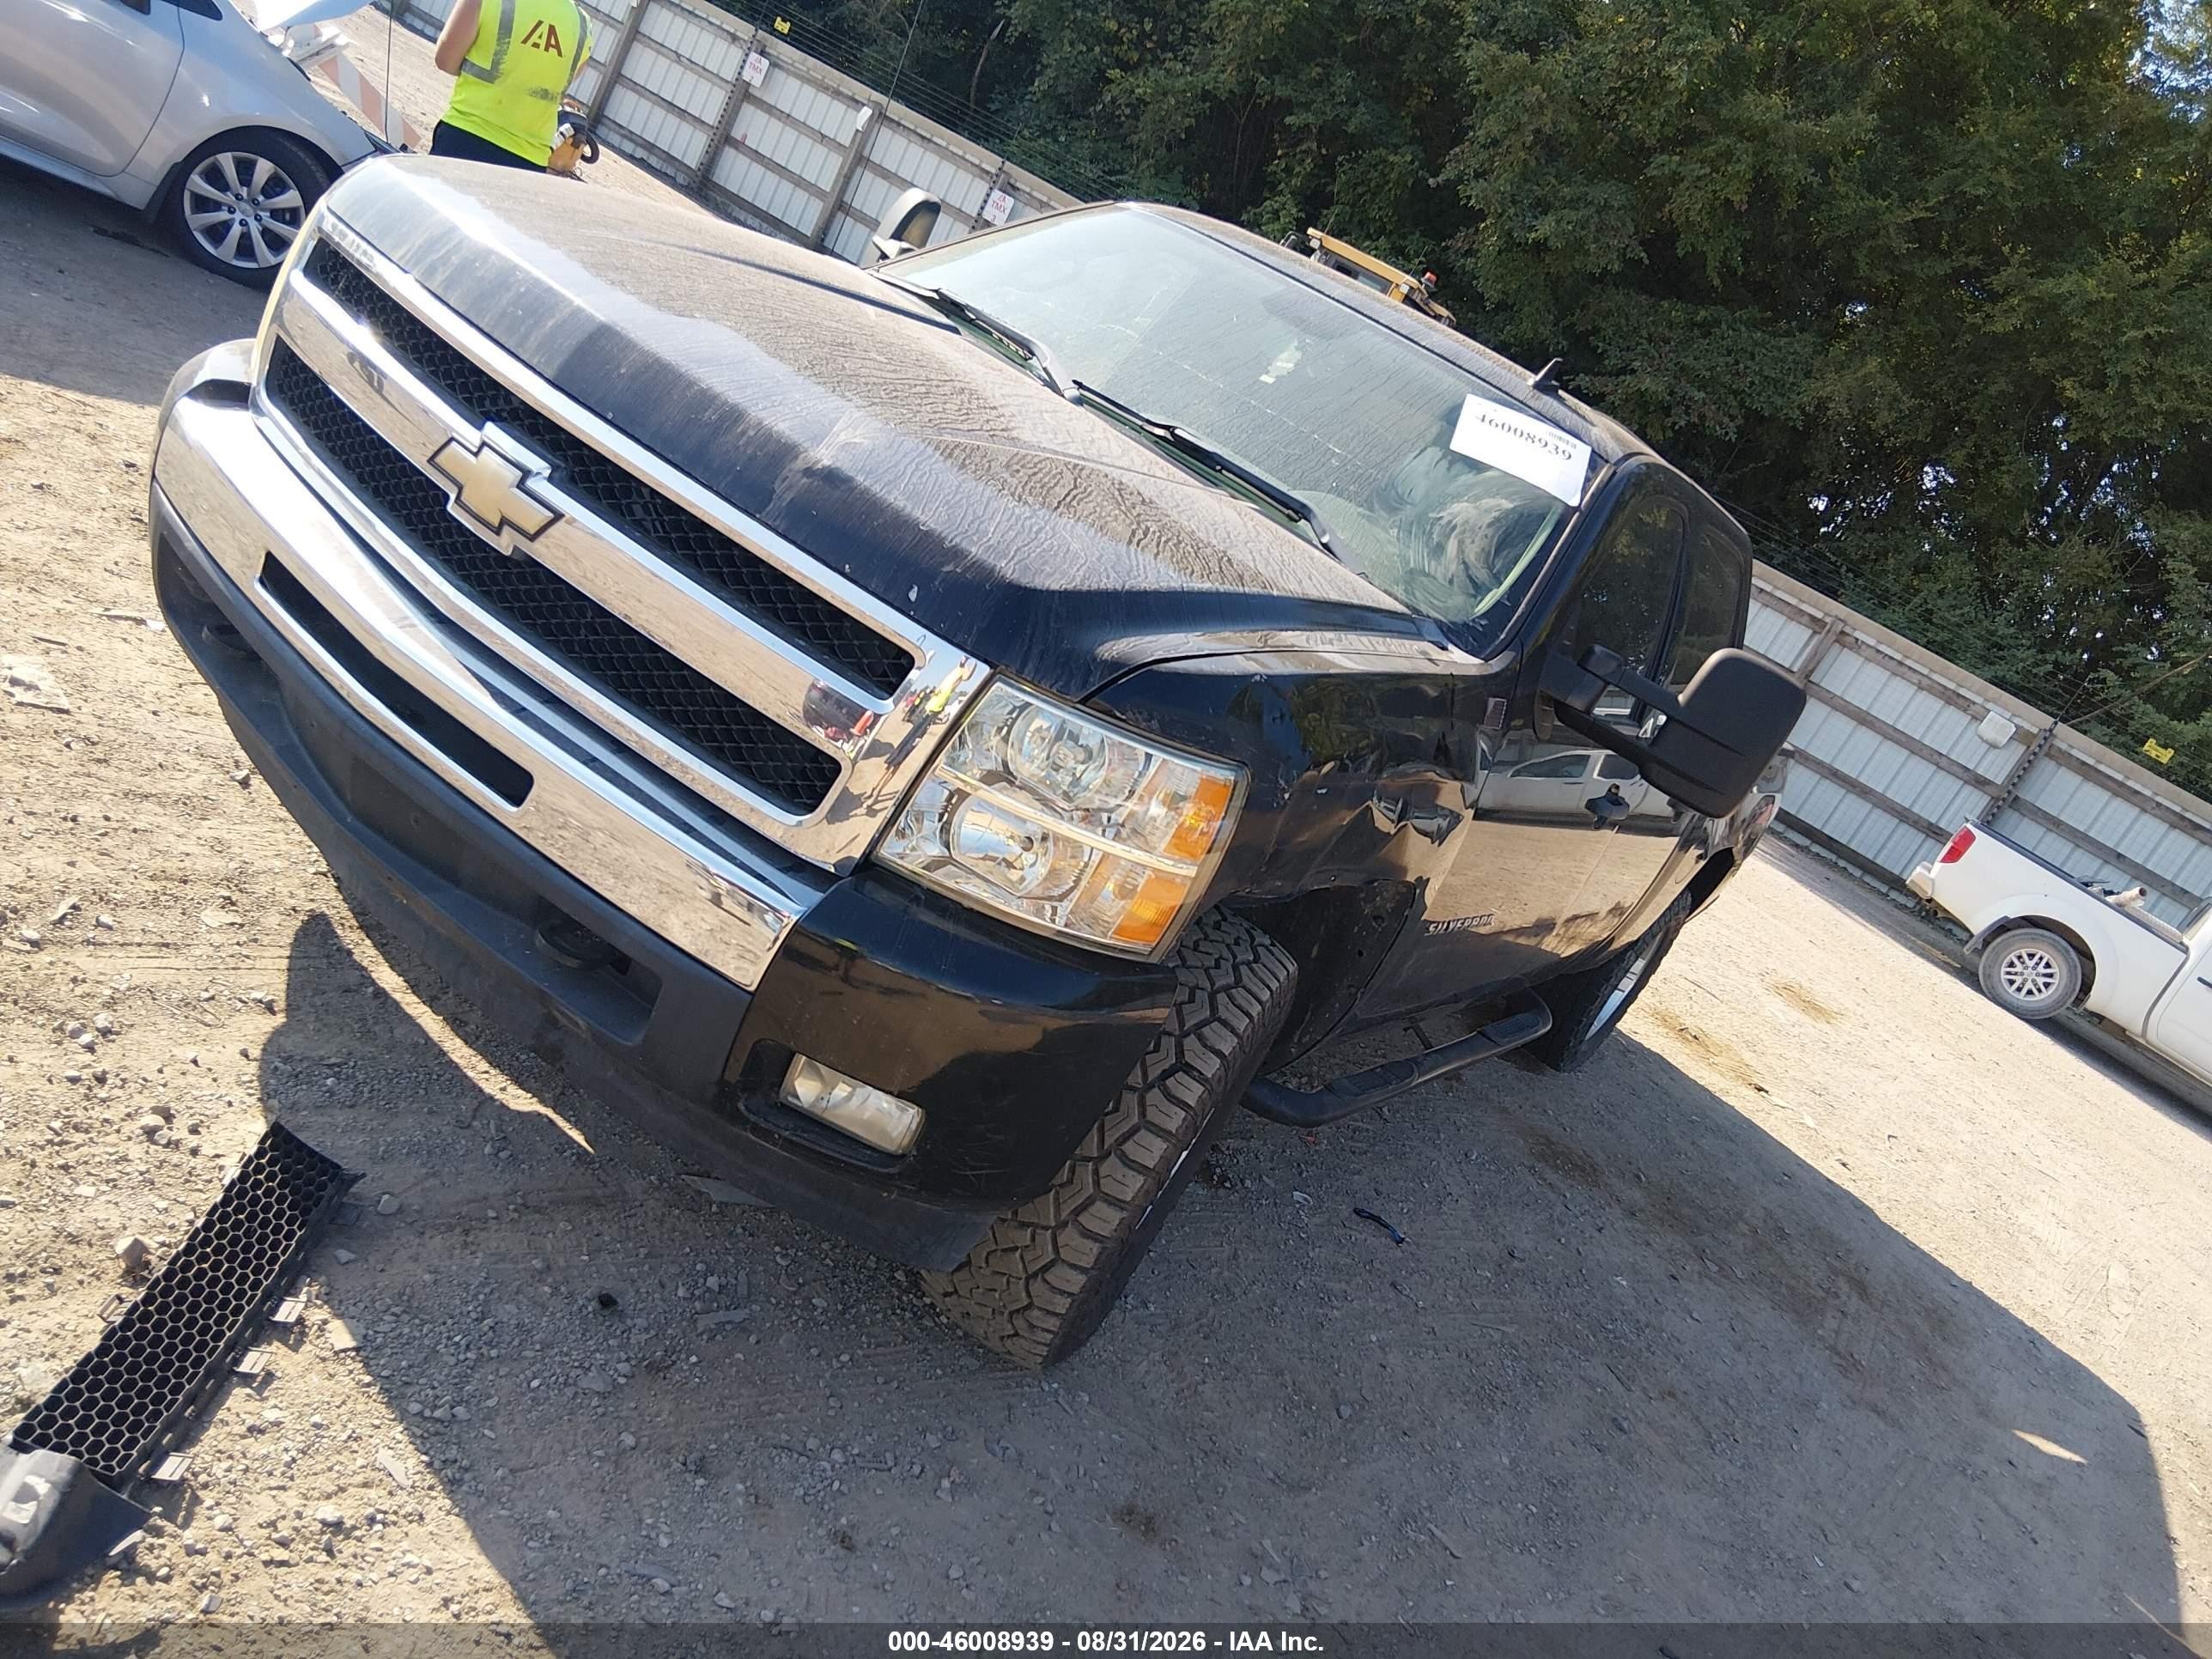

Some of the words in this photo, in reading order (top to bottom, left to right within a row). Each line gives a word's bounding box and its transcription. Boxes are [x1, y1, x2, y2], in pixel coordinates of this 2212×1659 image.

[991, 199, 1007, 215] TMX
[990, 214, 997, 222] 3
[1475, 413, 1572, 461] 46008939
